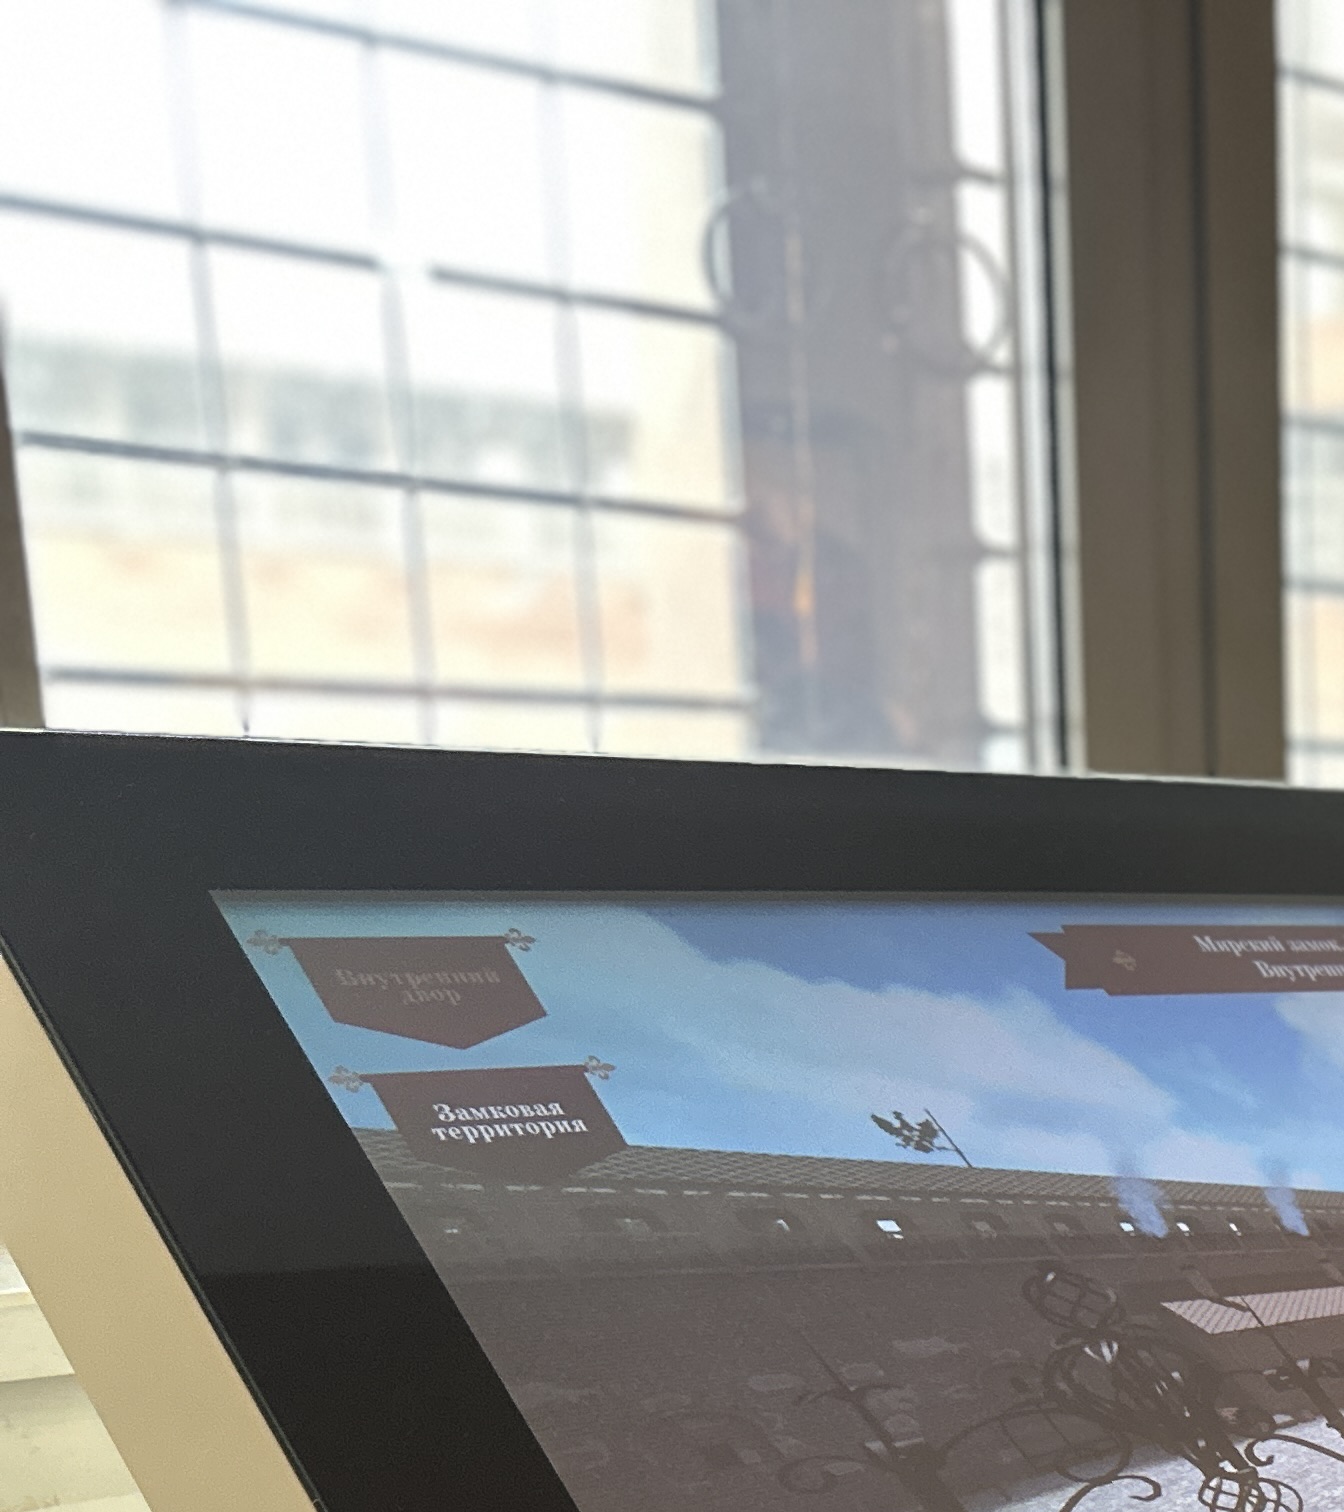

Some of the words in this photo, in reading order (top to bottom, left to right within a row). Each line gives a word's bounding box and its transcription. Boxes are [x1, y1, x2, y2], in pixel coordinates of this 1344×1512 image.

[1192, 934, 1286, 957] Мирский
[432, 1102, 566, 1122] Замковая
[431, 1118, 589, 1144] территория
